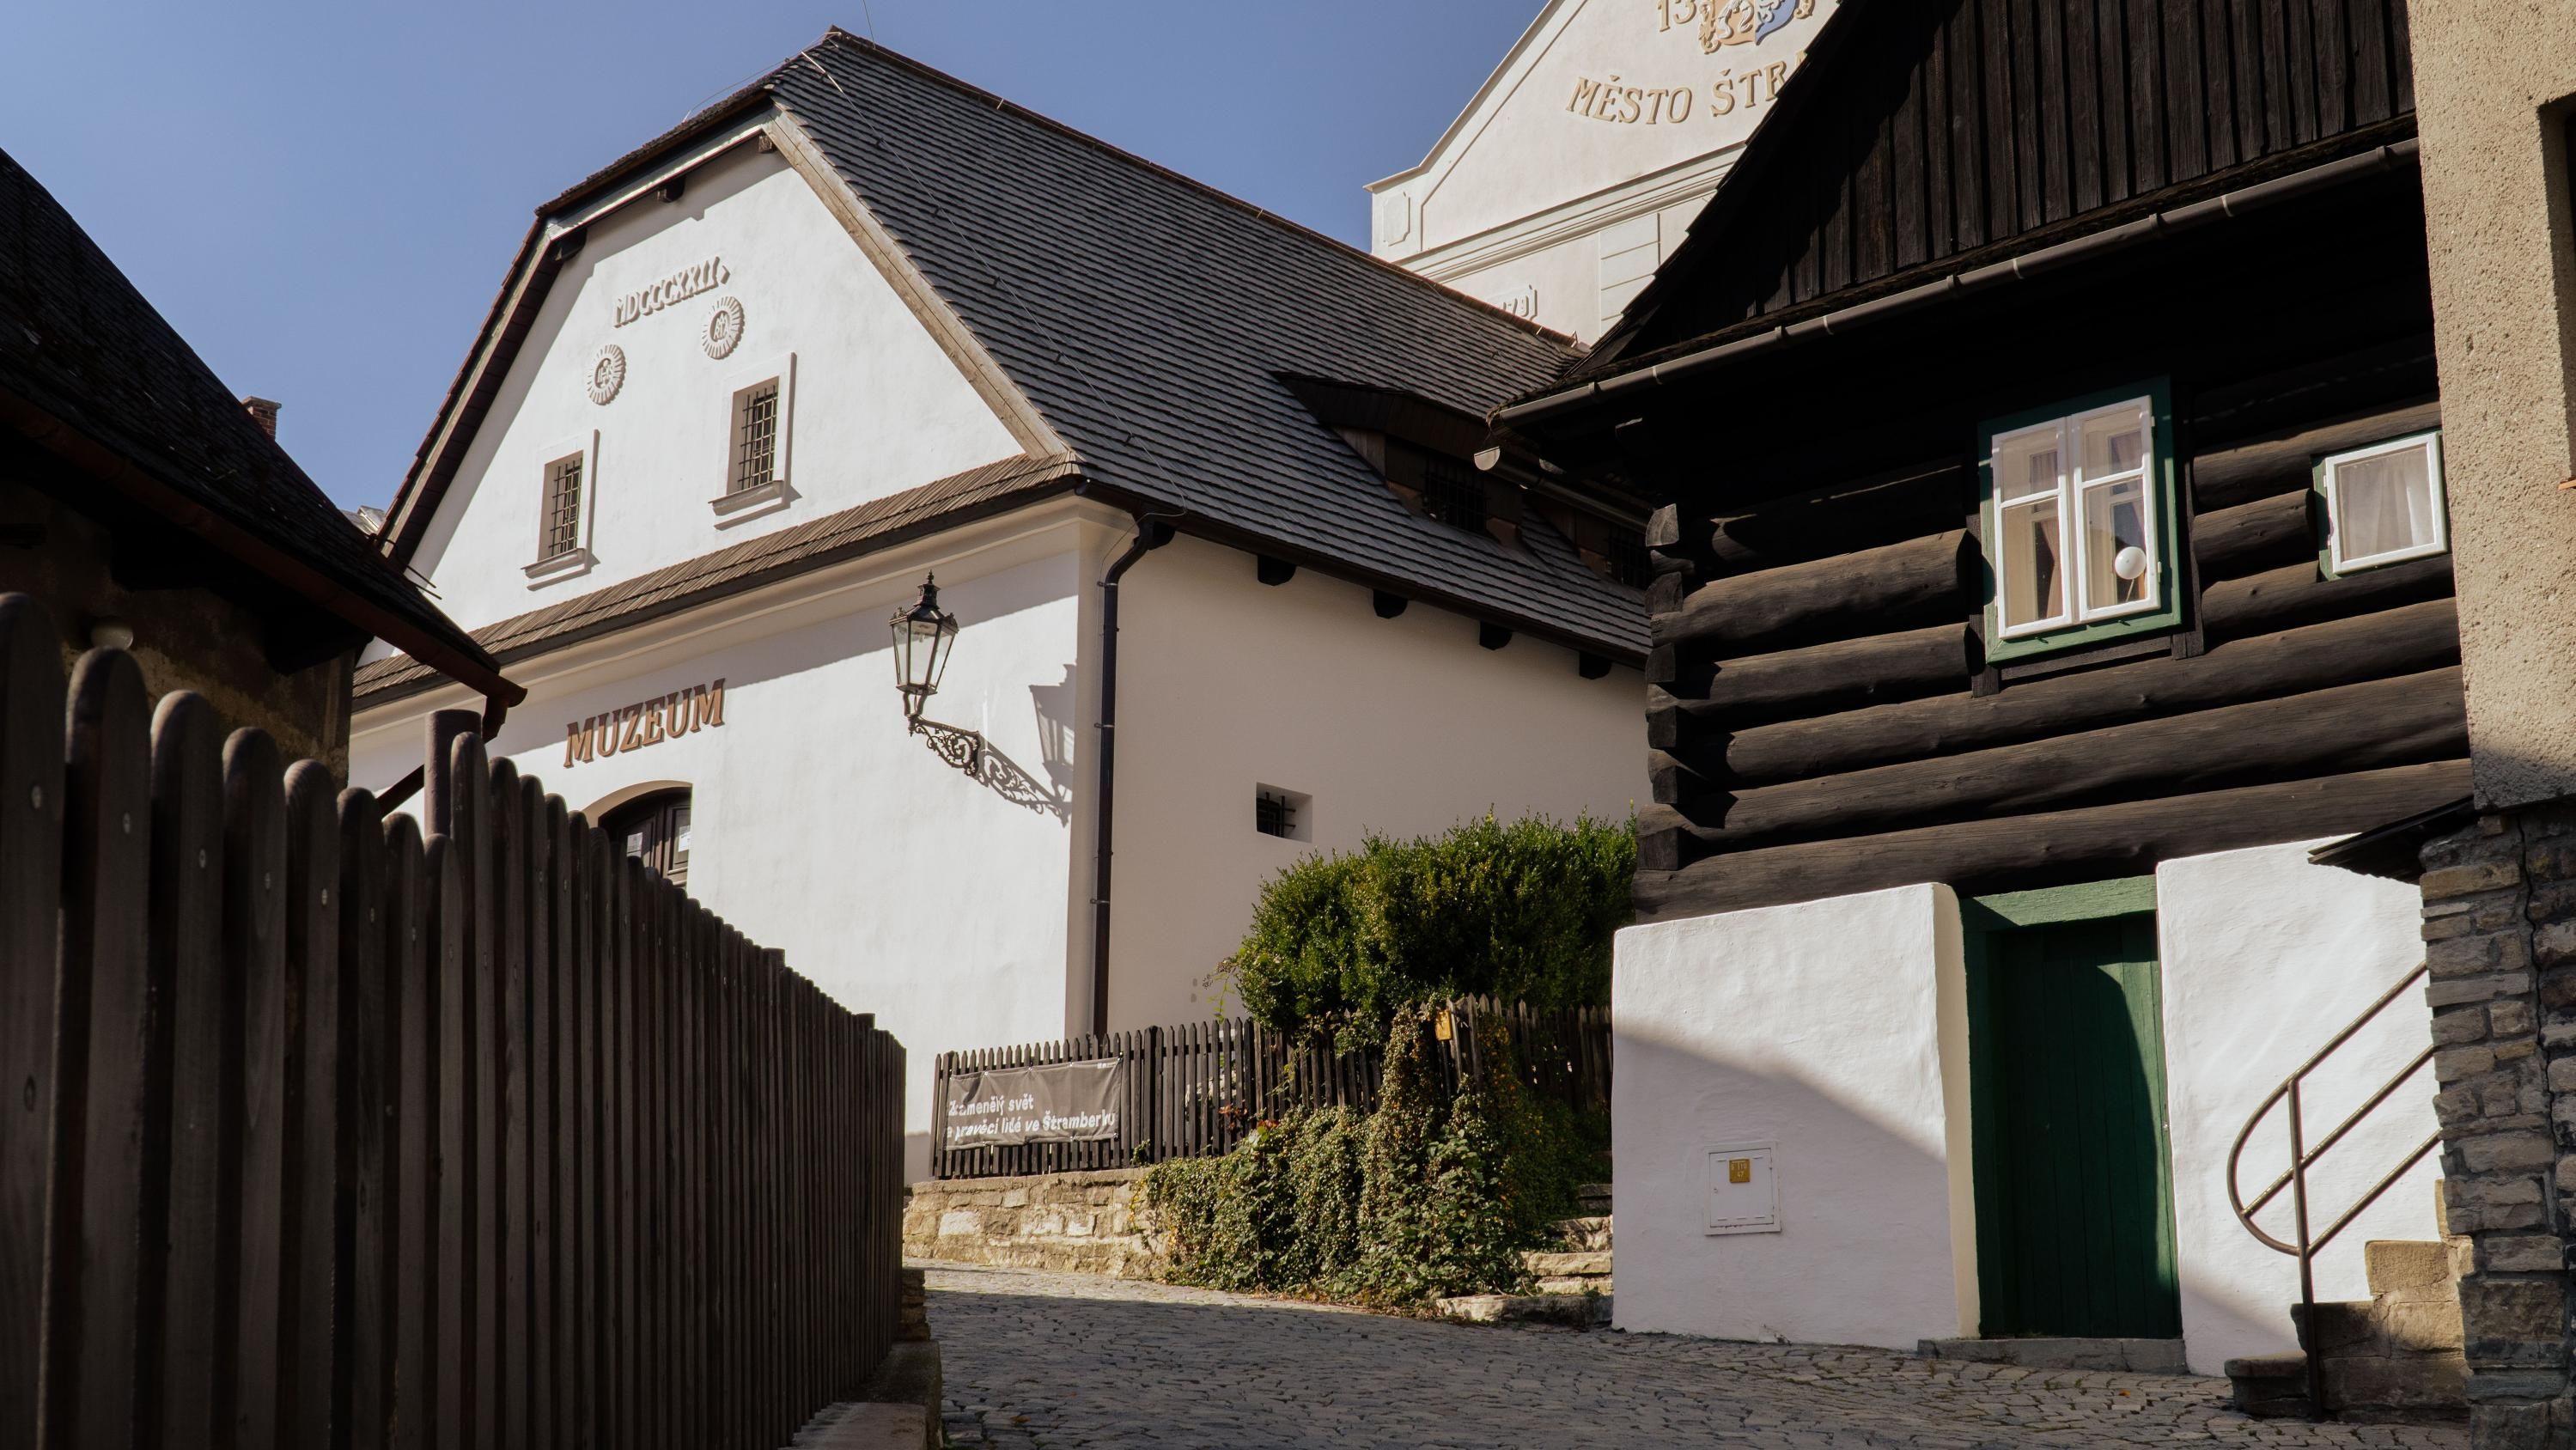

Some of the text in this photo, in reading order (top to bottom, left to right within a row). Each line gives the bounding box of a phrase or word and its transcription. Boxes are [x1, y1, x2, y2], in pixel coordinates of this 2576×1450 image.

[1565, 50, 1807, 125] MĚSTO ŠTR
[563, 678, 726, 768] MUZEUM
[1008, 1093, 1034, 1112] svět
[1025, 1119, 1040, 1131] ve
